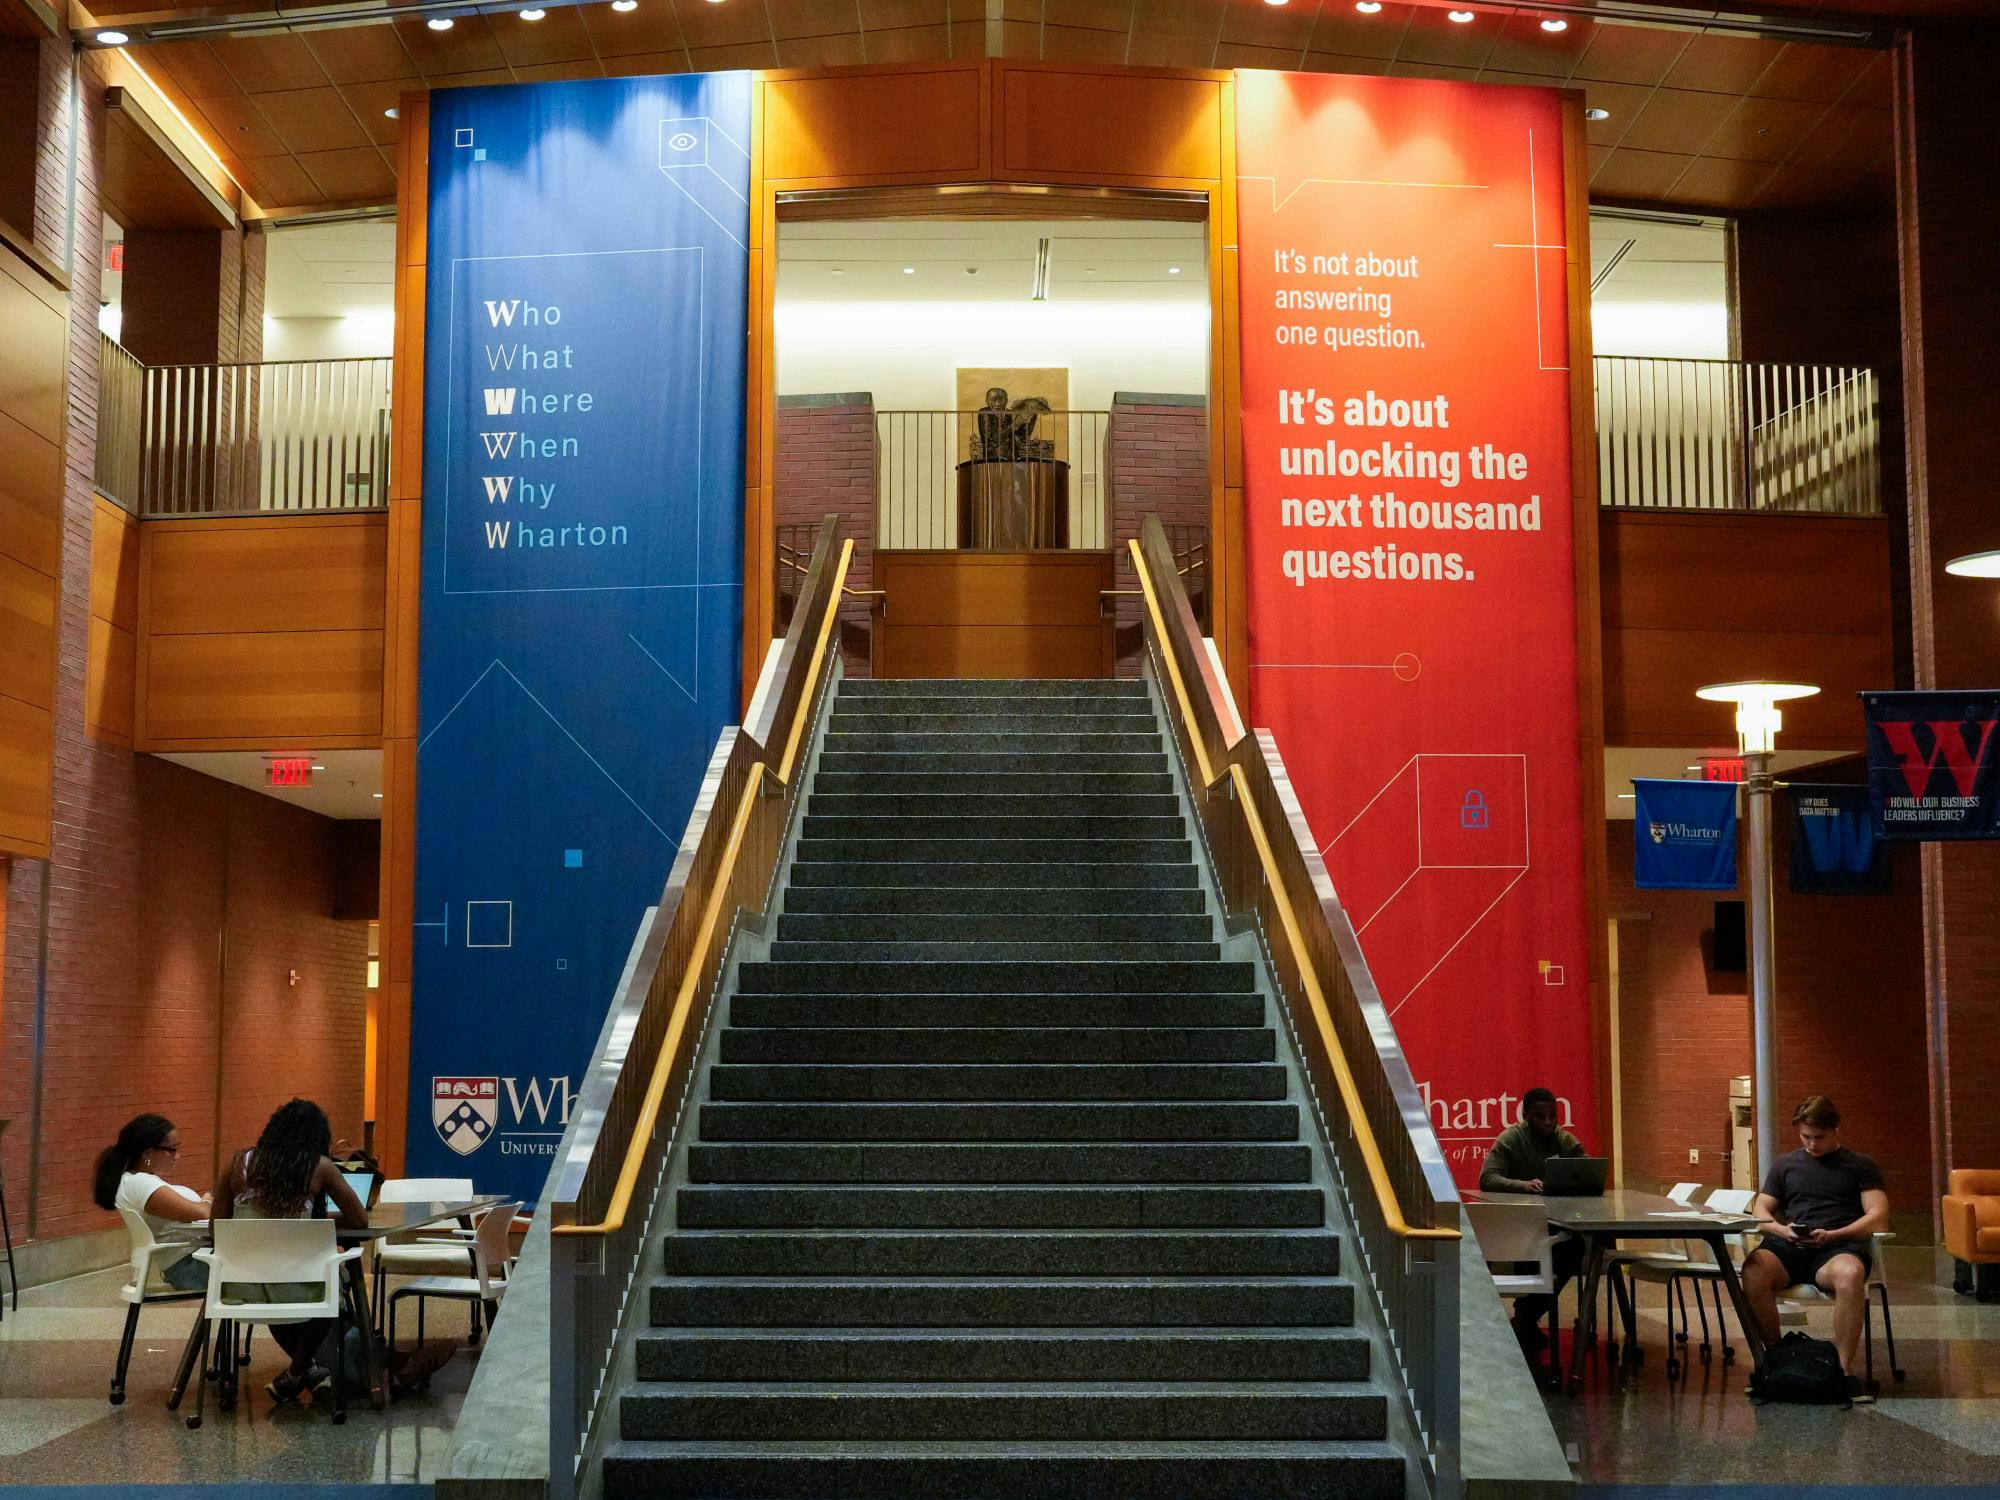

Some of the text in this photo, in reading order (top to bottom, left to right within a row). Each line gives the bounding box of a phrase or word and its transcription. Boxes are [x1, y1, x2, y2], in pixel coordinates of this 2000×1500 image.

[1275, 249, 1418, 278] It’s not about
[484, 300, 561, 327] Who
[1275, 288, 1391, 318] answering
[1276, 323, 1425, 351] one question.
[486, 344, 573, 372] What
[483, 388, 594, 416] Where
[1279, 389, 1449, 428] It’s about
[479, 432, 578, 459] When
[1280, 440, 1528, 487] unlocking the
[482, 476, 555, 508] Why
[1281, 492, 1541, 531] next thousand
[485, 522, 628, 549] Wharton
[1282, 543, 1475, 586] questions.
[272, 759, 309, 785] EXIT
[1707, 760, 1744, 782] EXIT
[1884, 809, 1965, 821] LEADERS INFLUENCE?
[1922, 796, 1939, 808] OUR
[1941, 796, 1980, 808] BUSINESS
[1667, 823, 1721, 839] Wharton
[1452, 1146, 1469, 1163] of
